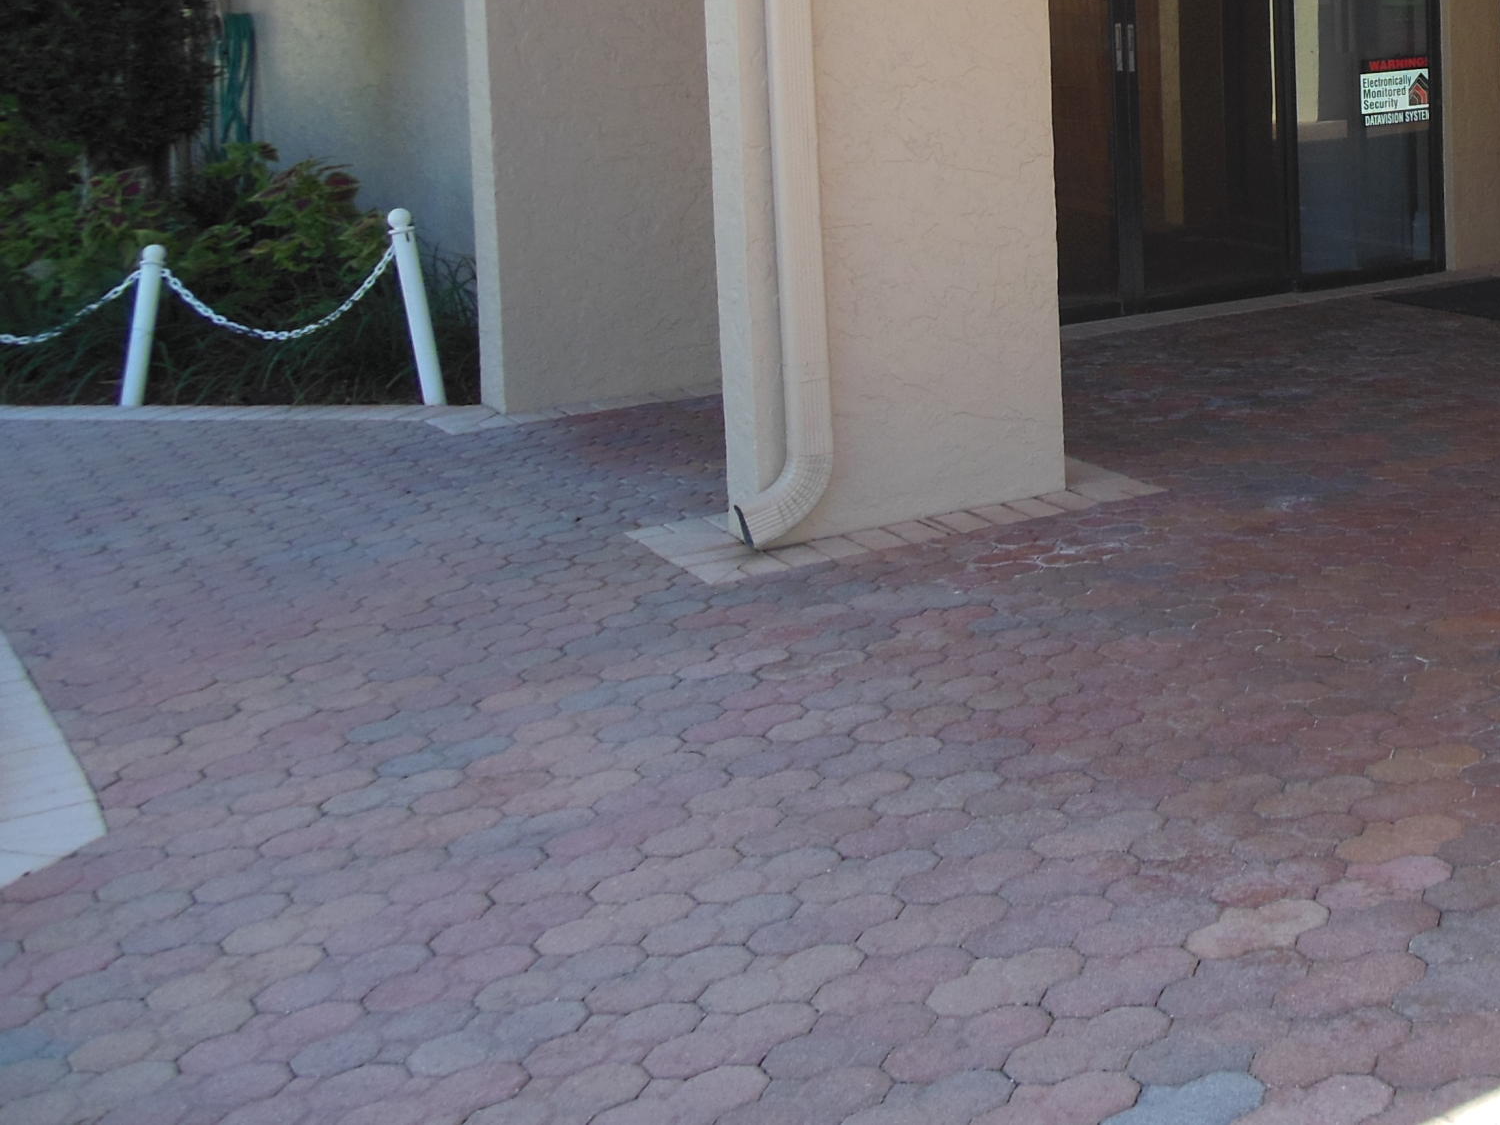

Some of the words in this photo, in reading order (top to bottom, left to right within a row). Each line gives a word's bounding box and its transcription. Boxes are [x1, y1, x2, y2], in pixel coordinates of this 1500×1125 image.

[1362, 75, 1412, 89] Electronically
[1363, 86, 1407, 100] Monitored
[1363, 98, 1398, 110] Security
[1365, 112, 1404, 127] DATAVISION
